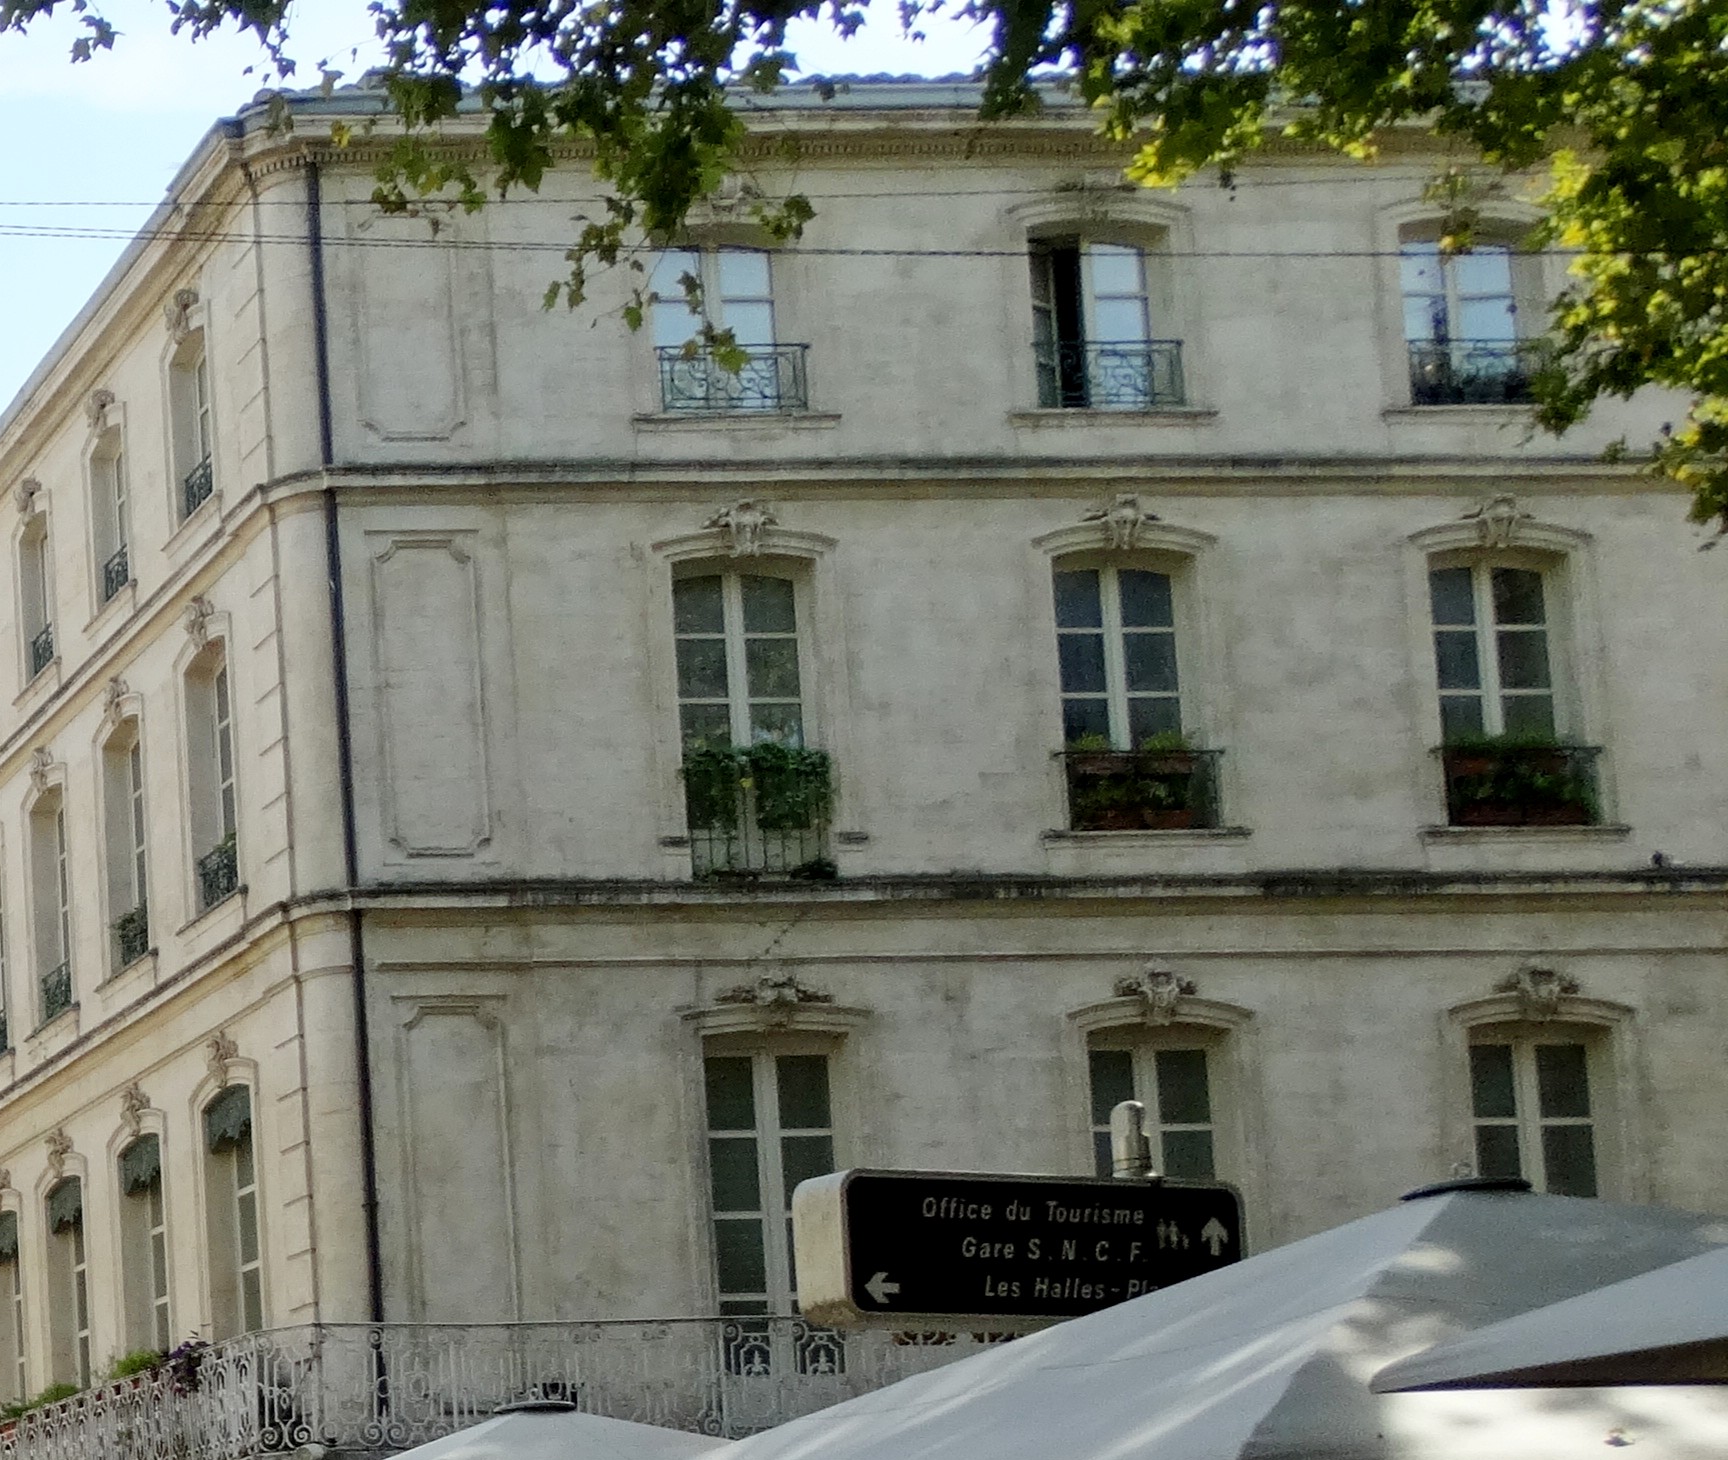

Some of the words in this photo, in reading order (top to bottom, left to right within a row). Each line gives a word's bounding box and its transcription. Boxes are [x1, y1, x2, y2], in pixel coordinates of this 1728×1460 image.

[922, 1197, 993, 1221] Office
[1006, 1200, 1031, 1222] du
[1046, 1201, 1145, 1226] Tourisme
[962, 1237, 1015, 1260] Gare
[985, 1275, 1021, 1298] Les
